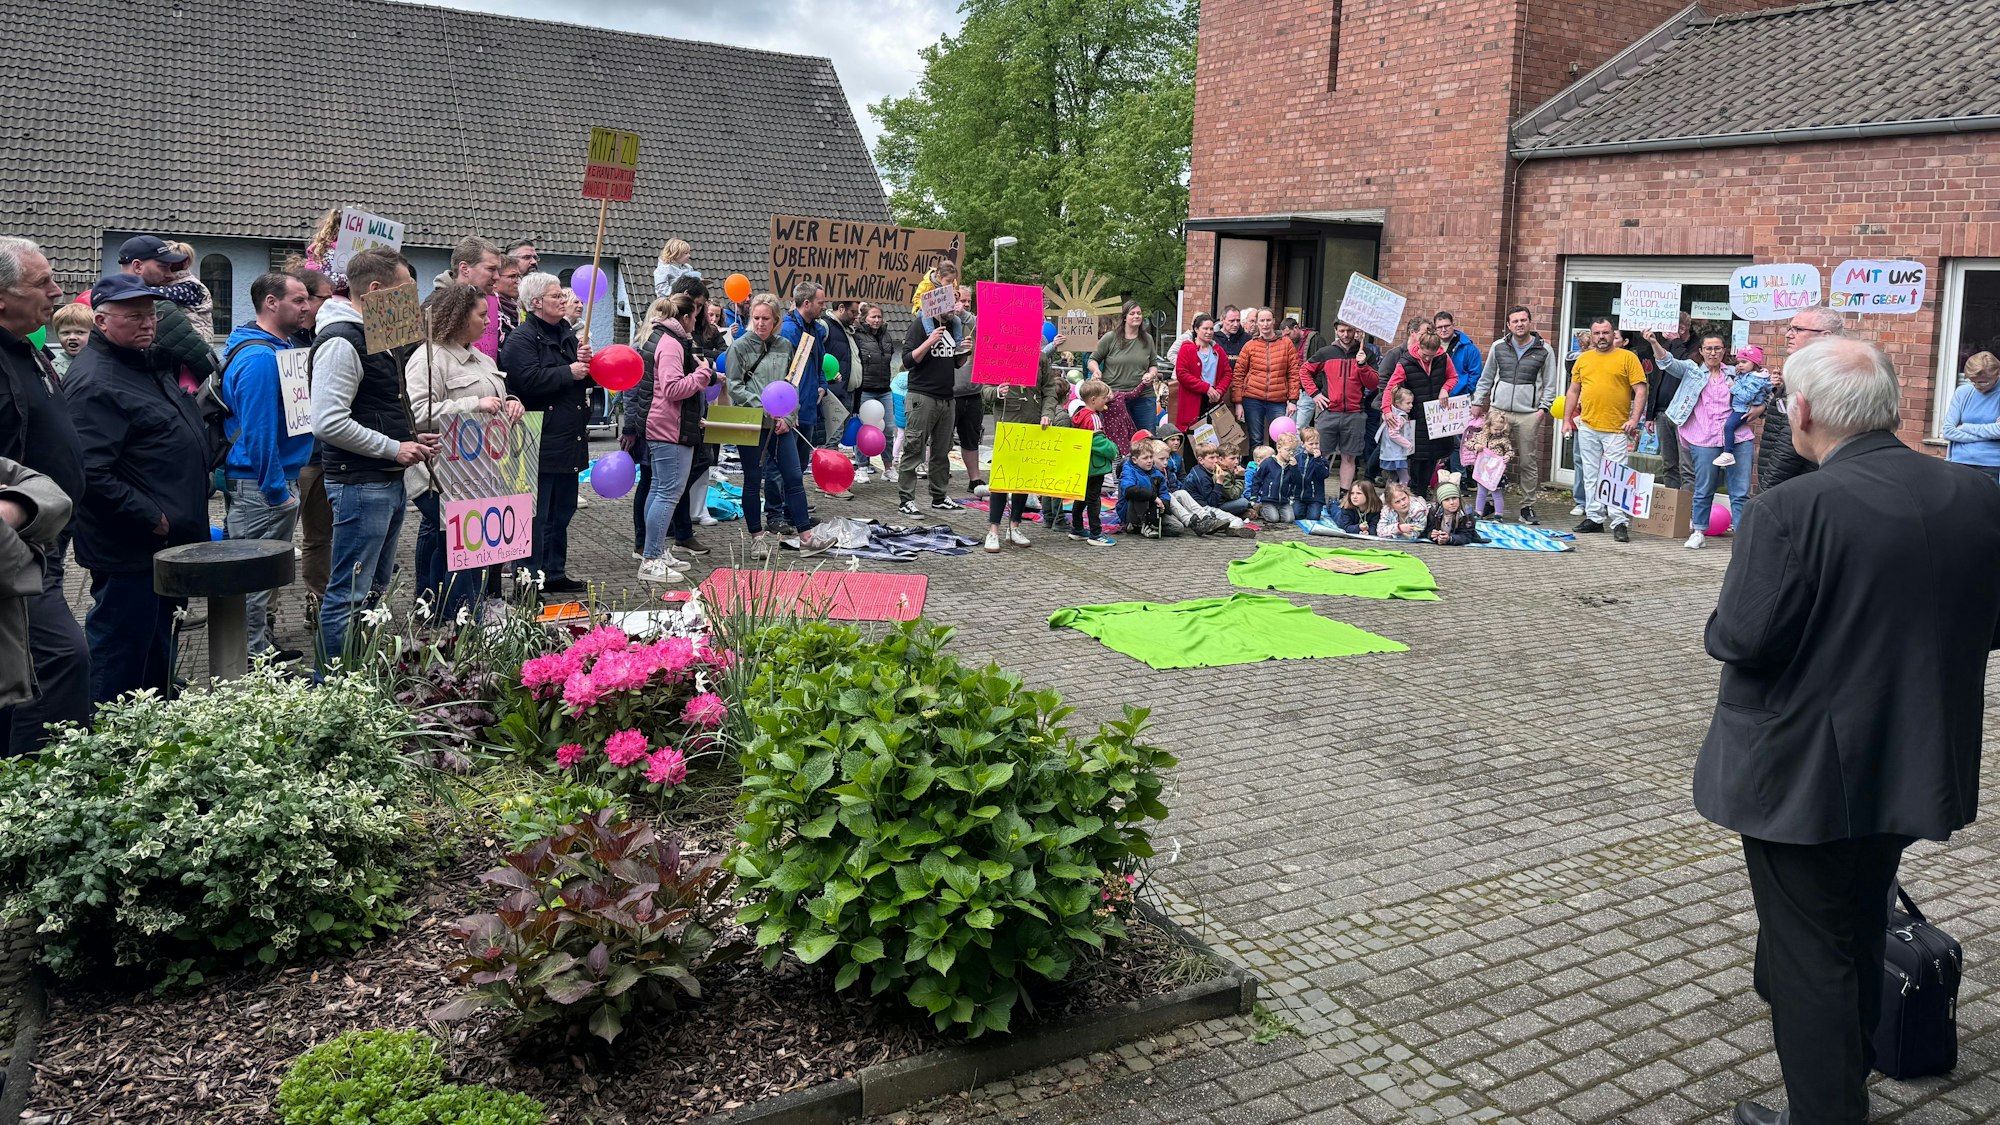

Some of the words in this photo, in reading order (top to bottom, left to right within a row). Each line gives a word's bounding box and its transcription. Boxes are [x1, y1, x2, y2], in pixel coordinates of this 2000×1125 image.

[345, 214, 363, 232] ICH
[367, 219, 394, 240] WILL
[776, 218, 820, 242] WER
[829, 223, 865, 245] EIN
[866, 226, 915, 251] AMT
[877, 251, 909, 272] MUSS
[911, 254, 946, 274] AUC
[1740, 275, 1758, 289] ICH
[1763, 275, 1788, 288] WILL
[1791, 274, 1806, 286] IN
[1846, 268, 1882, 284] MIT
[1888, 269, 1923, 285] UNS
[1626, 284, 1679, 300] Kommuni
[1742, 291, 1769, 305] DEN
[1830, 291, 1871, 307] STATT
[1872, 294, 1907, 305] GEGEN
[379, 305, 415, 327] WOLLEN
[1061, 317, 1072, 325] ICH
[1077, 317, 1094, 325] WILL
[1627, 308, 1679, 320] SCHLÜSSEL
[384, 325, 416, 345] KITA
[930, 345, 957, 358] adid
[1432, 414, 1443, 424] IN
[1449, 411, 1464, 420] DIE
[1442, 422, 1465, 433] KITA
[998, 425, 1063, 452] Kitazeit
[1022, 457, 1056, 467] unsere
[1604, 459, 1637, 489] KITA
[1662, 513, 1674, 522] GUT
[452, 551, 470, 568] ist
[476, 549, 492, 564] nix
